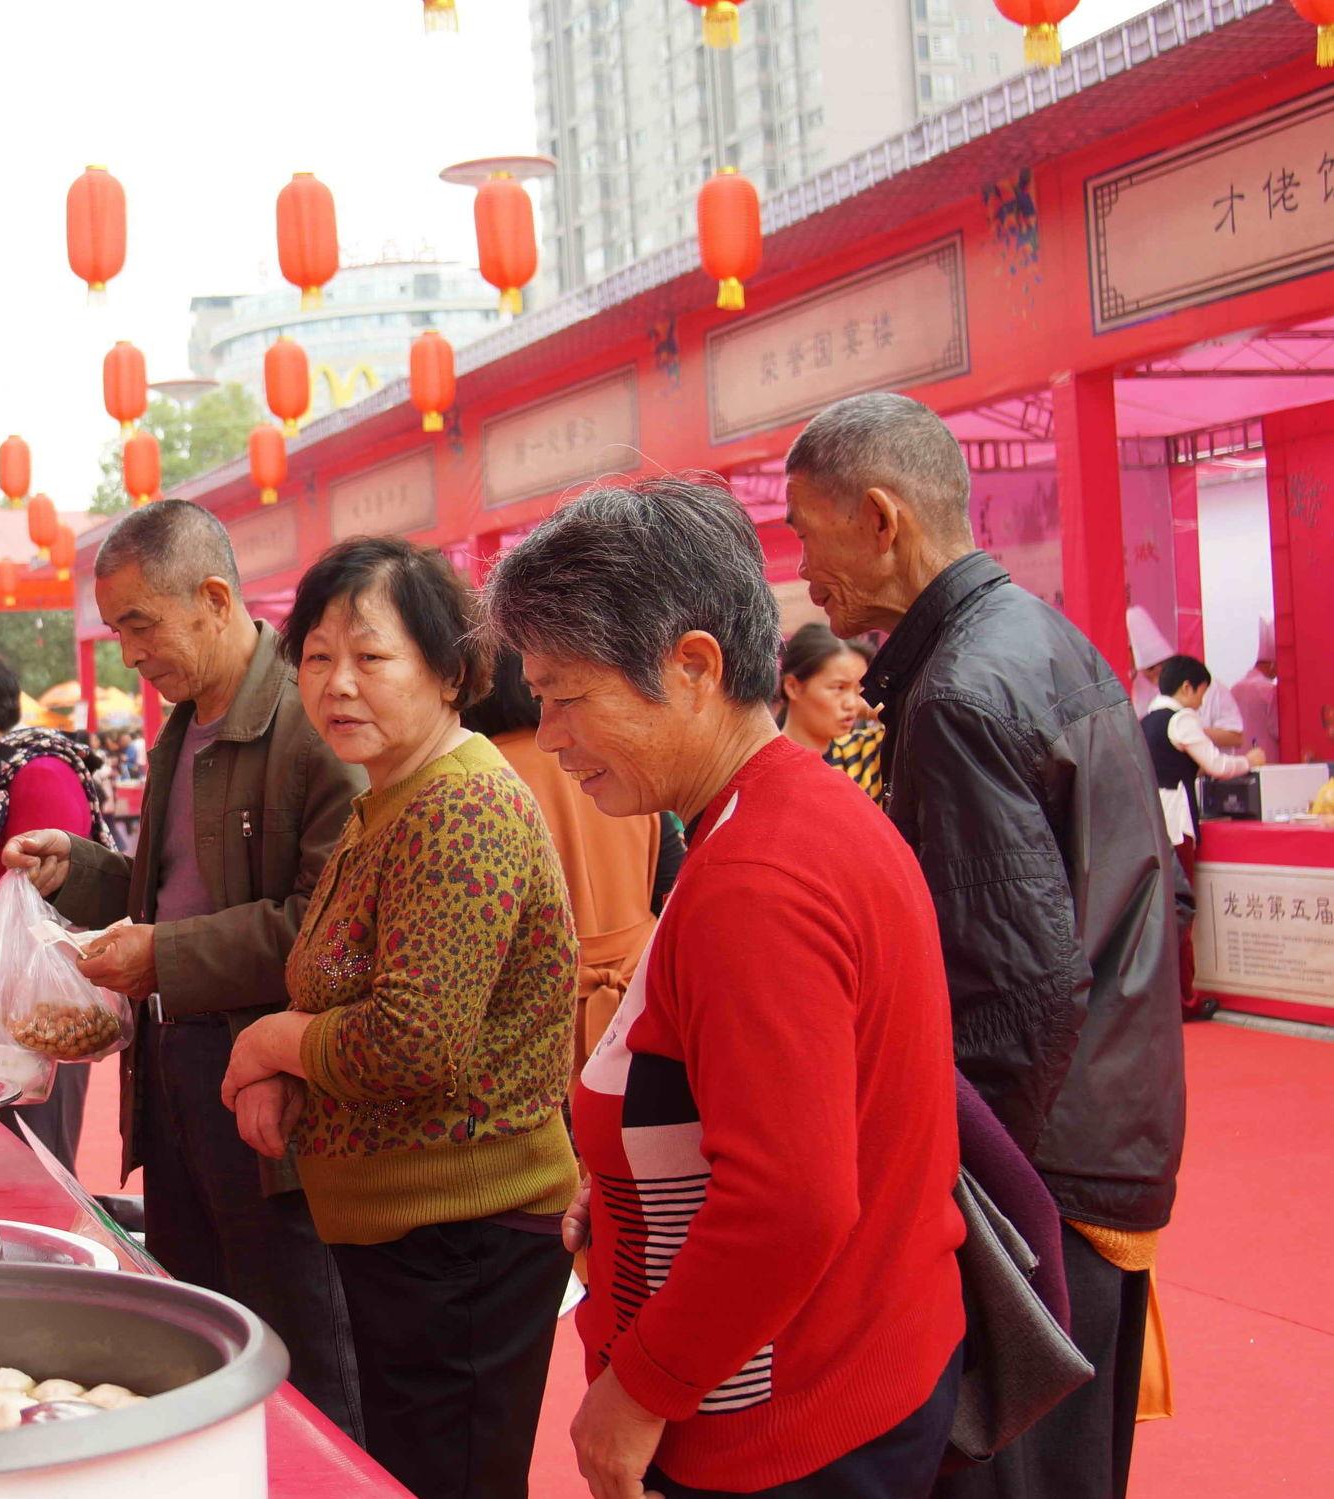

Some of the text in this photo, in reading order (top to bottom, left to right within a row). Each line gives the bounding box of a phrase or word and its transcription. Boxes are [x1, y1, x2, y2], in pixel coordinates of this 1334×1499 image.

[1223, 890, 1334, 926] 龙岩第五届
